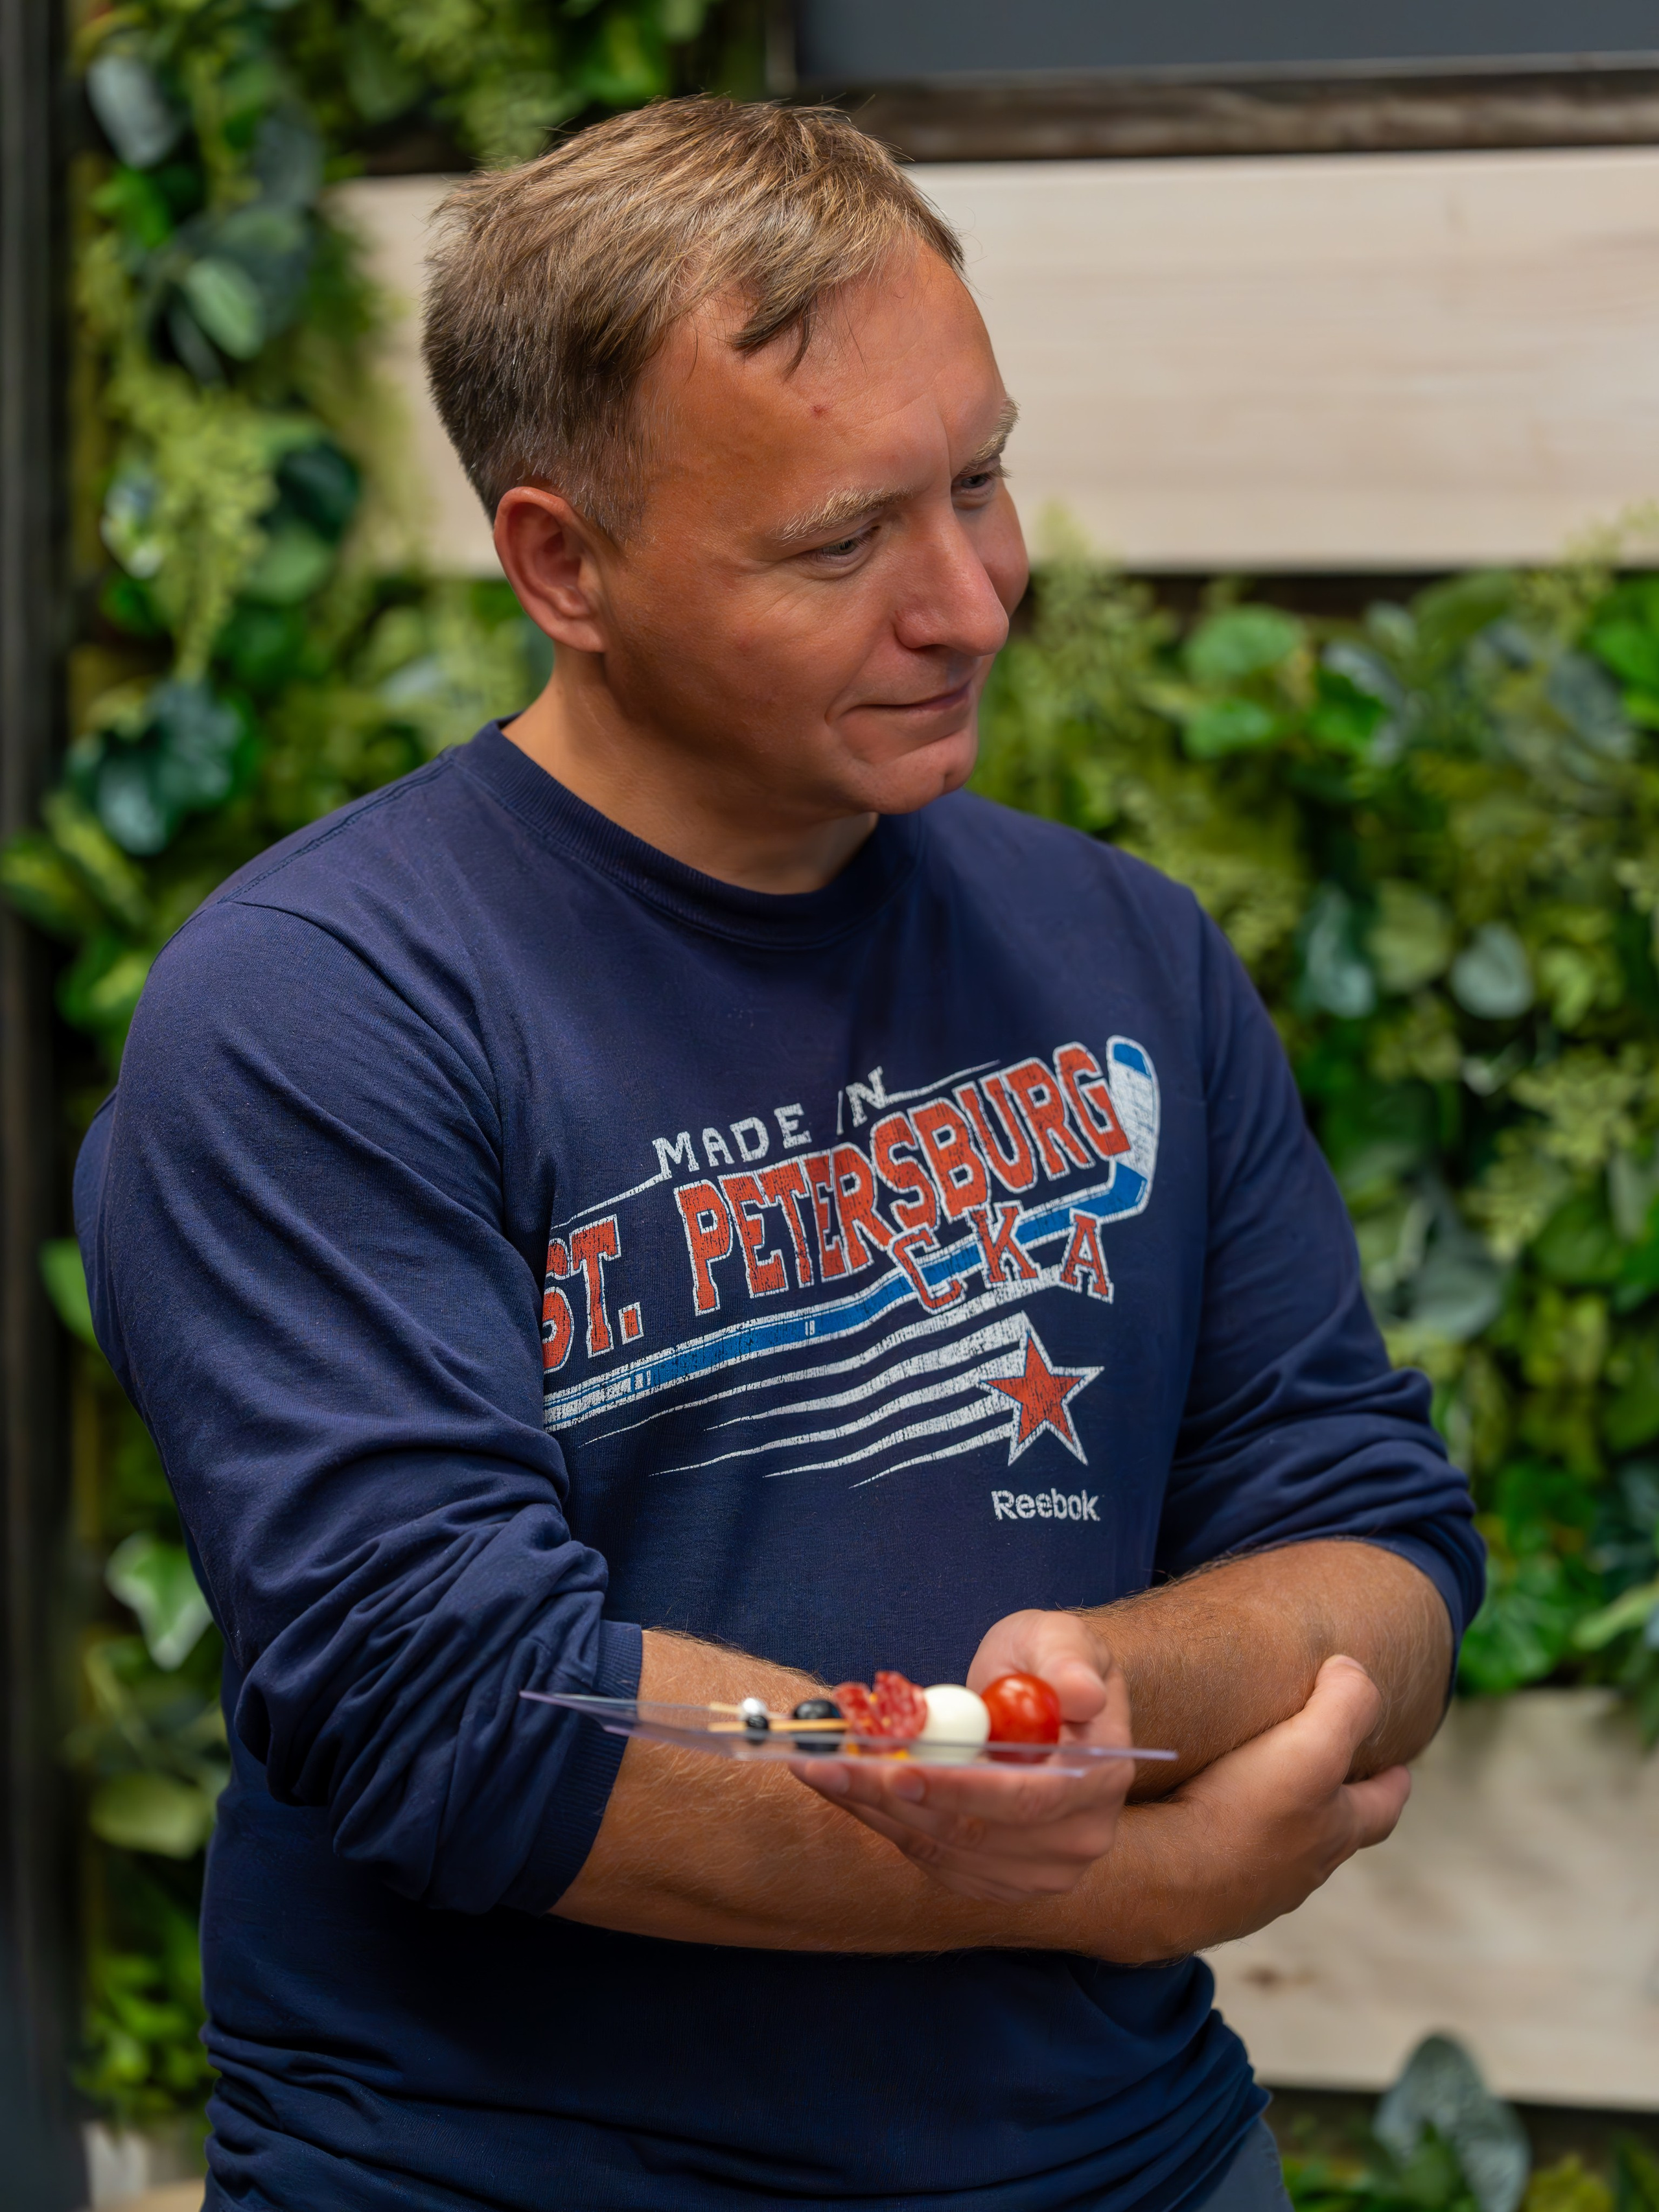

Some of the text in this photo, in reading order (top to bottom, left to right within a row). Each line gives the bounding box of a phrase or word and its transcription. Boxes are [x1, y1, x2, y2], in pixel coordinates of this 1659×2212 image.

[652, 1066, 887, 1180] MADE IN
[673, 1041, 1131, 1316] PETERSBURG
[991, 1488, 1100, 1521] Reebok
